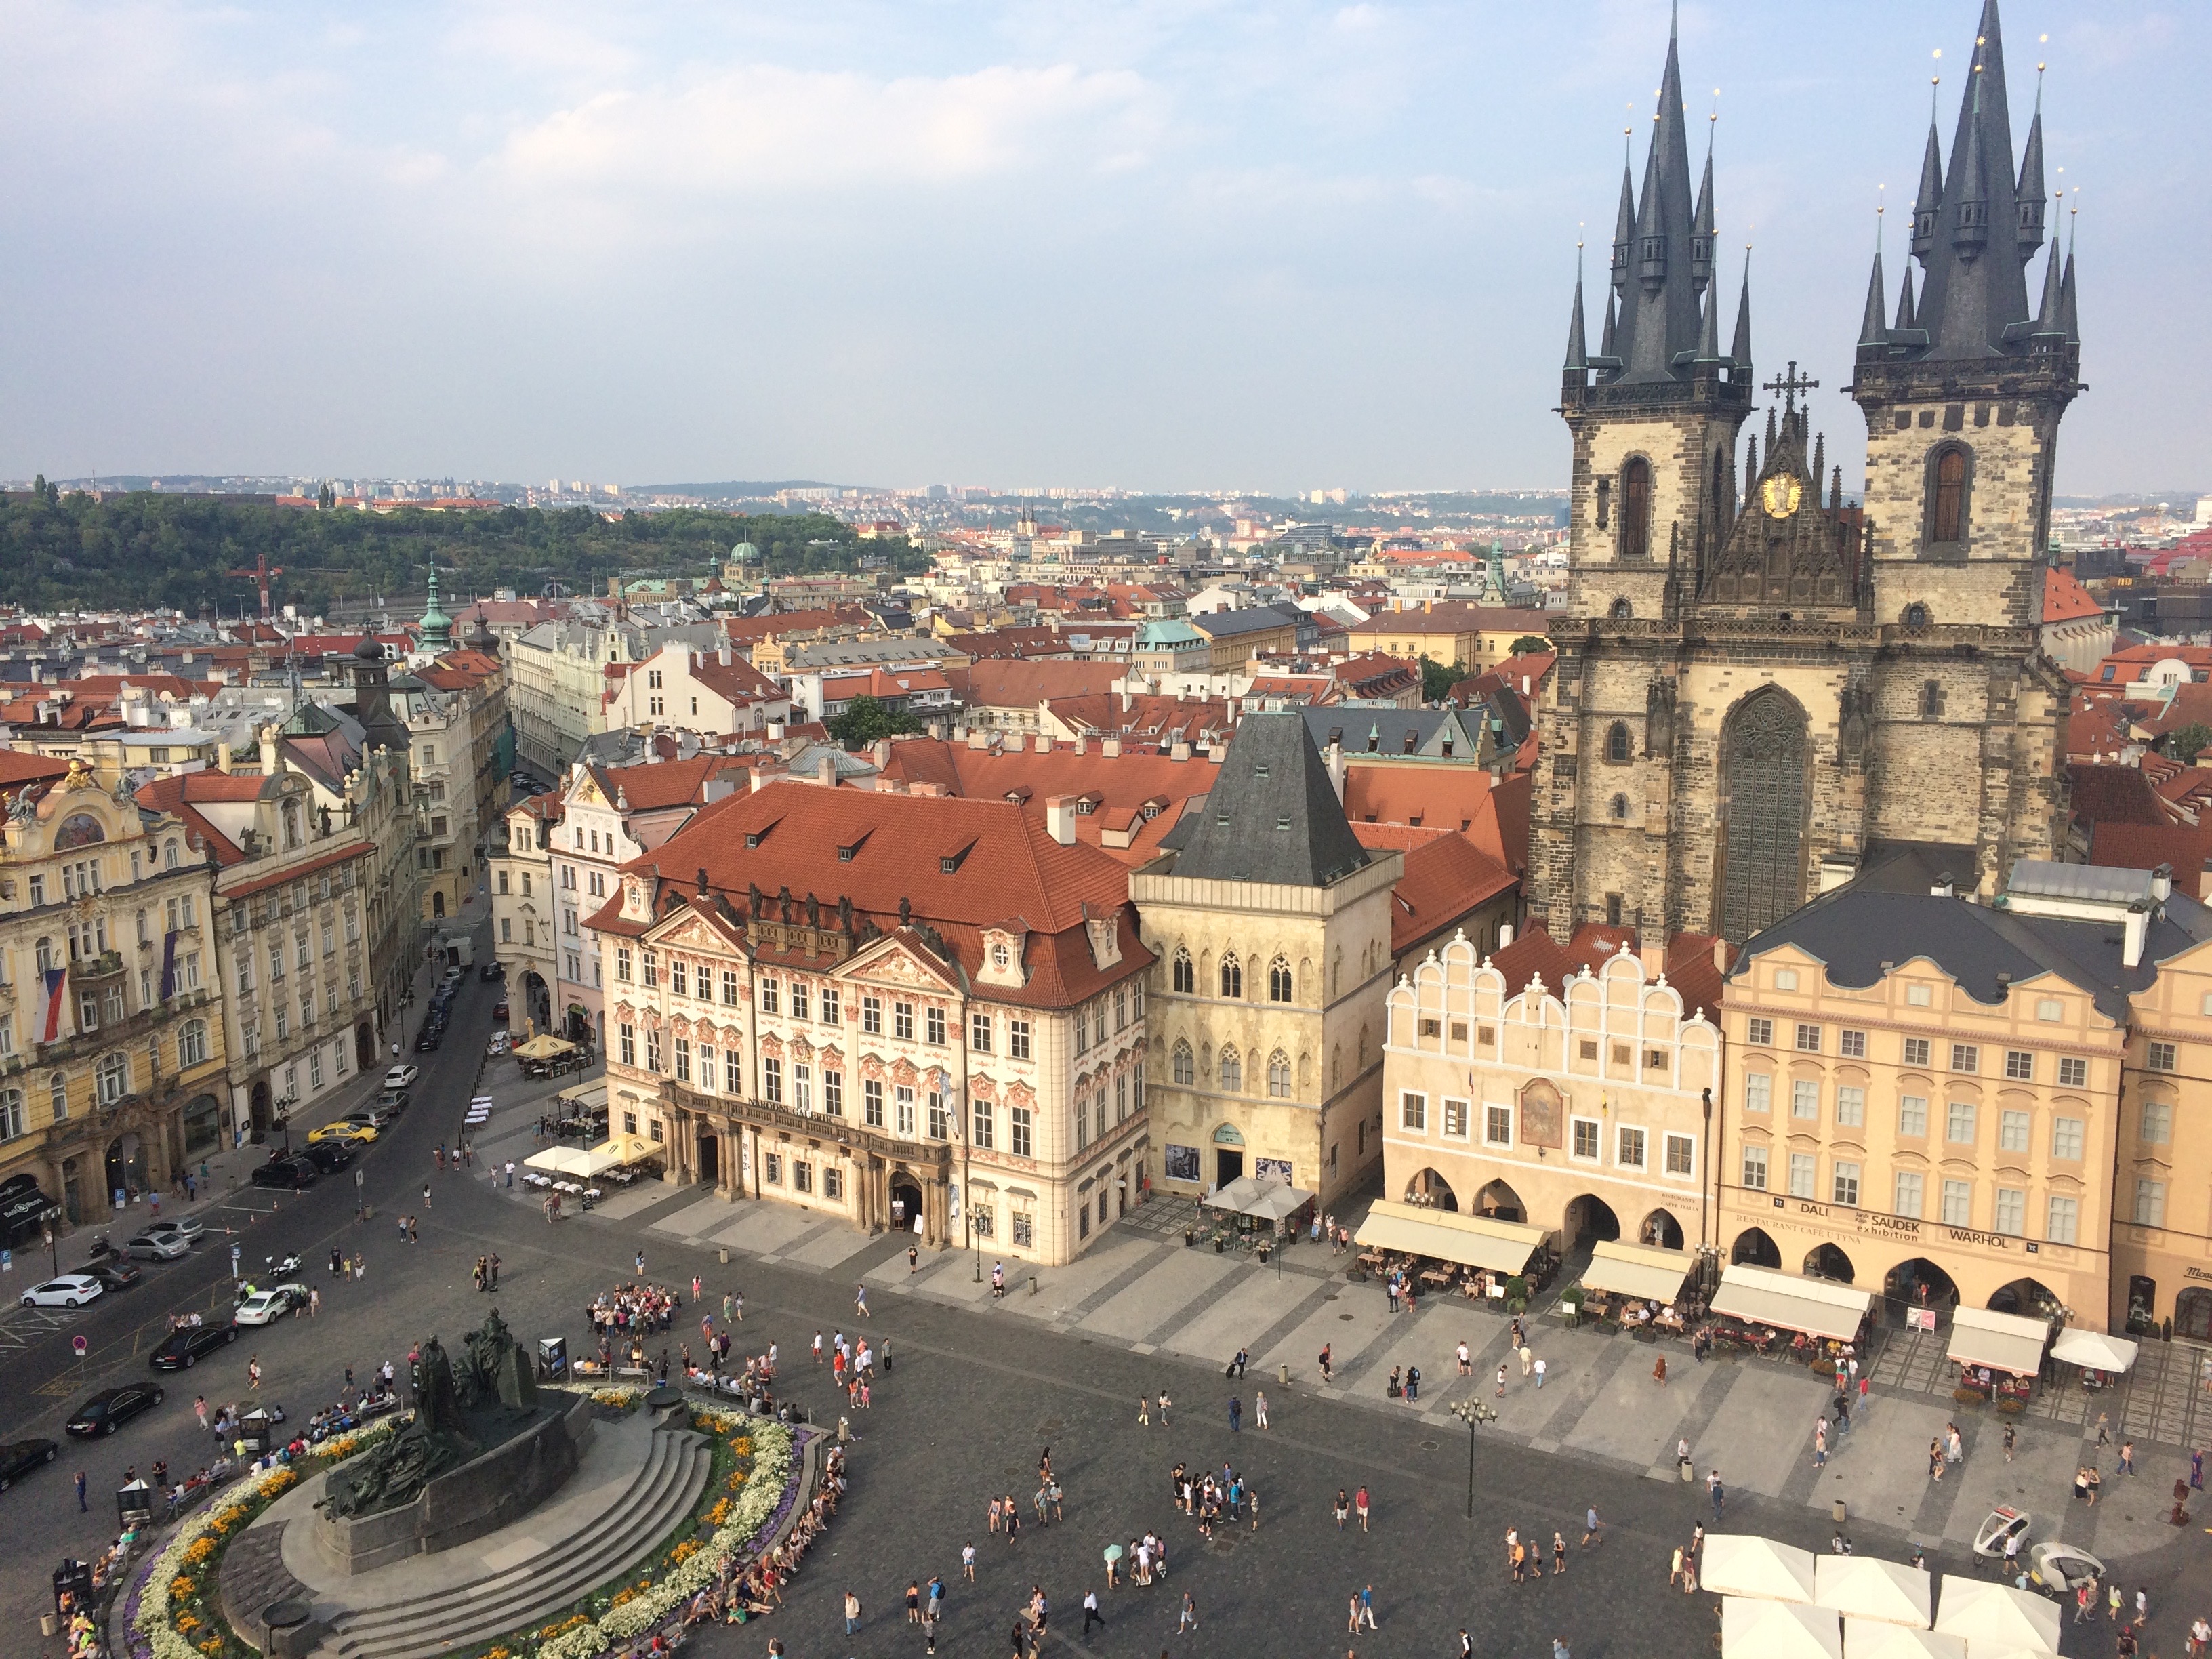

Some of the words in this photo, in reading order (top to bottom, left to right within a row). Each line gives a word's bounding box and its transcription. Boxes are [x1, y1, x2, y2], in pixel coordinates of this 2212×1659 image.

[1800, 1203, 1829, 1217] DALÍ
[1736, 1214, 1797, 1232] RESTAURANT
[1871, 1215, 1921, 1233] SAUDEK
[1857, 1225, 1919, 1242] exhibition
[1950, 1229, 2009, 1249] WARHOL
